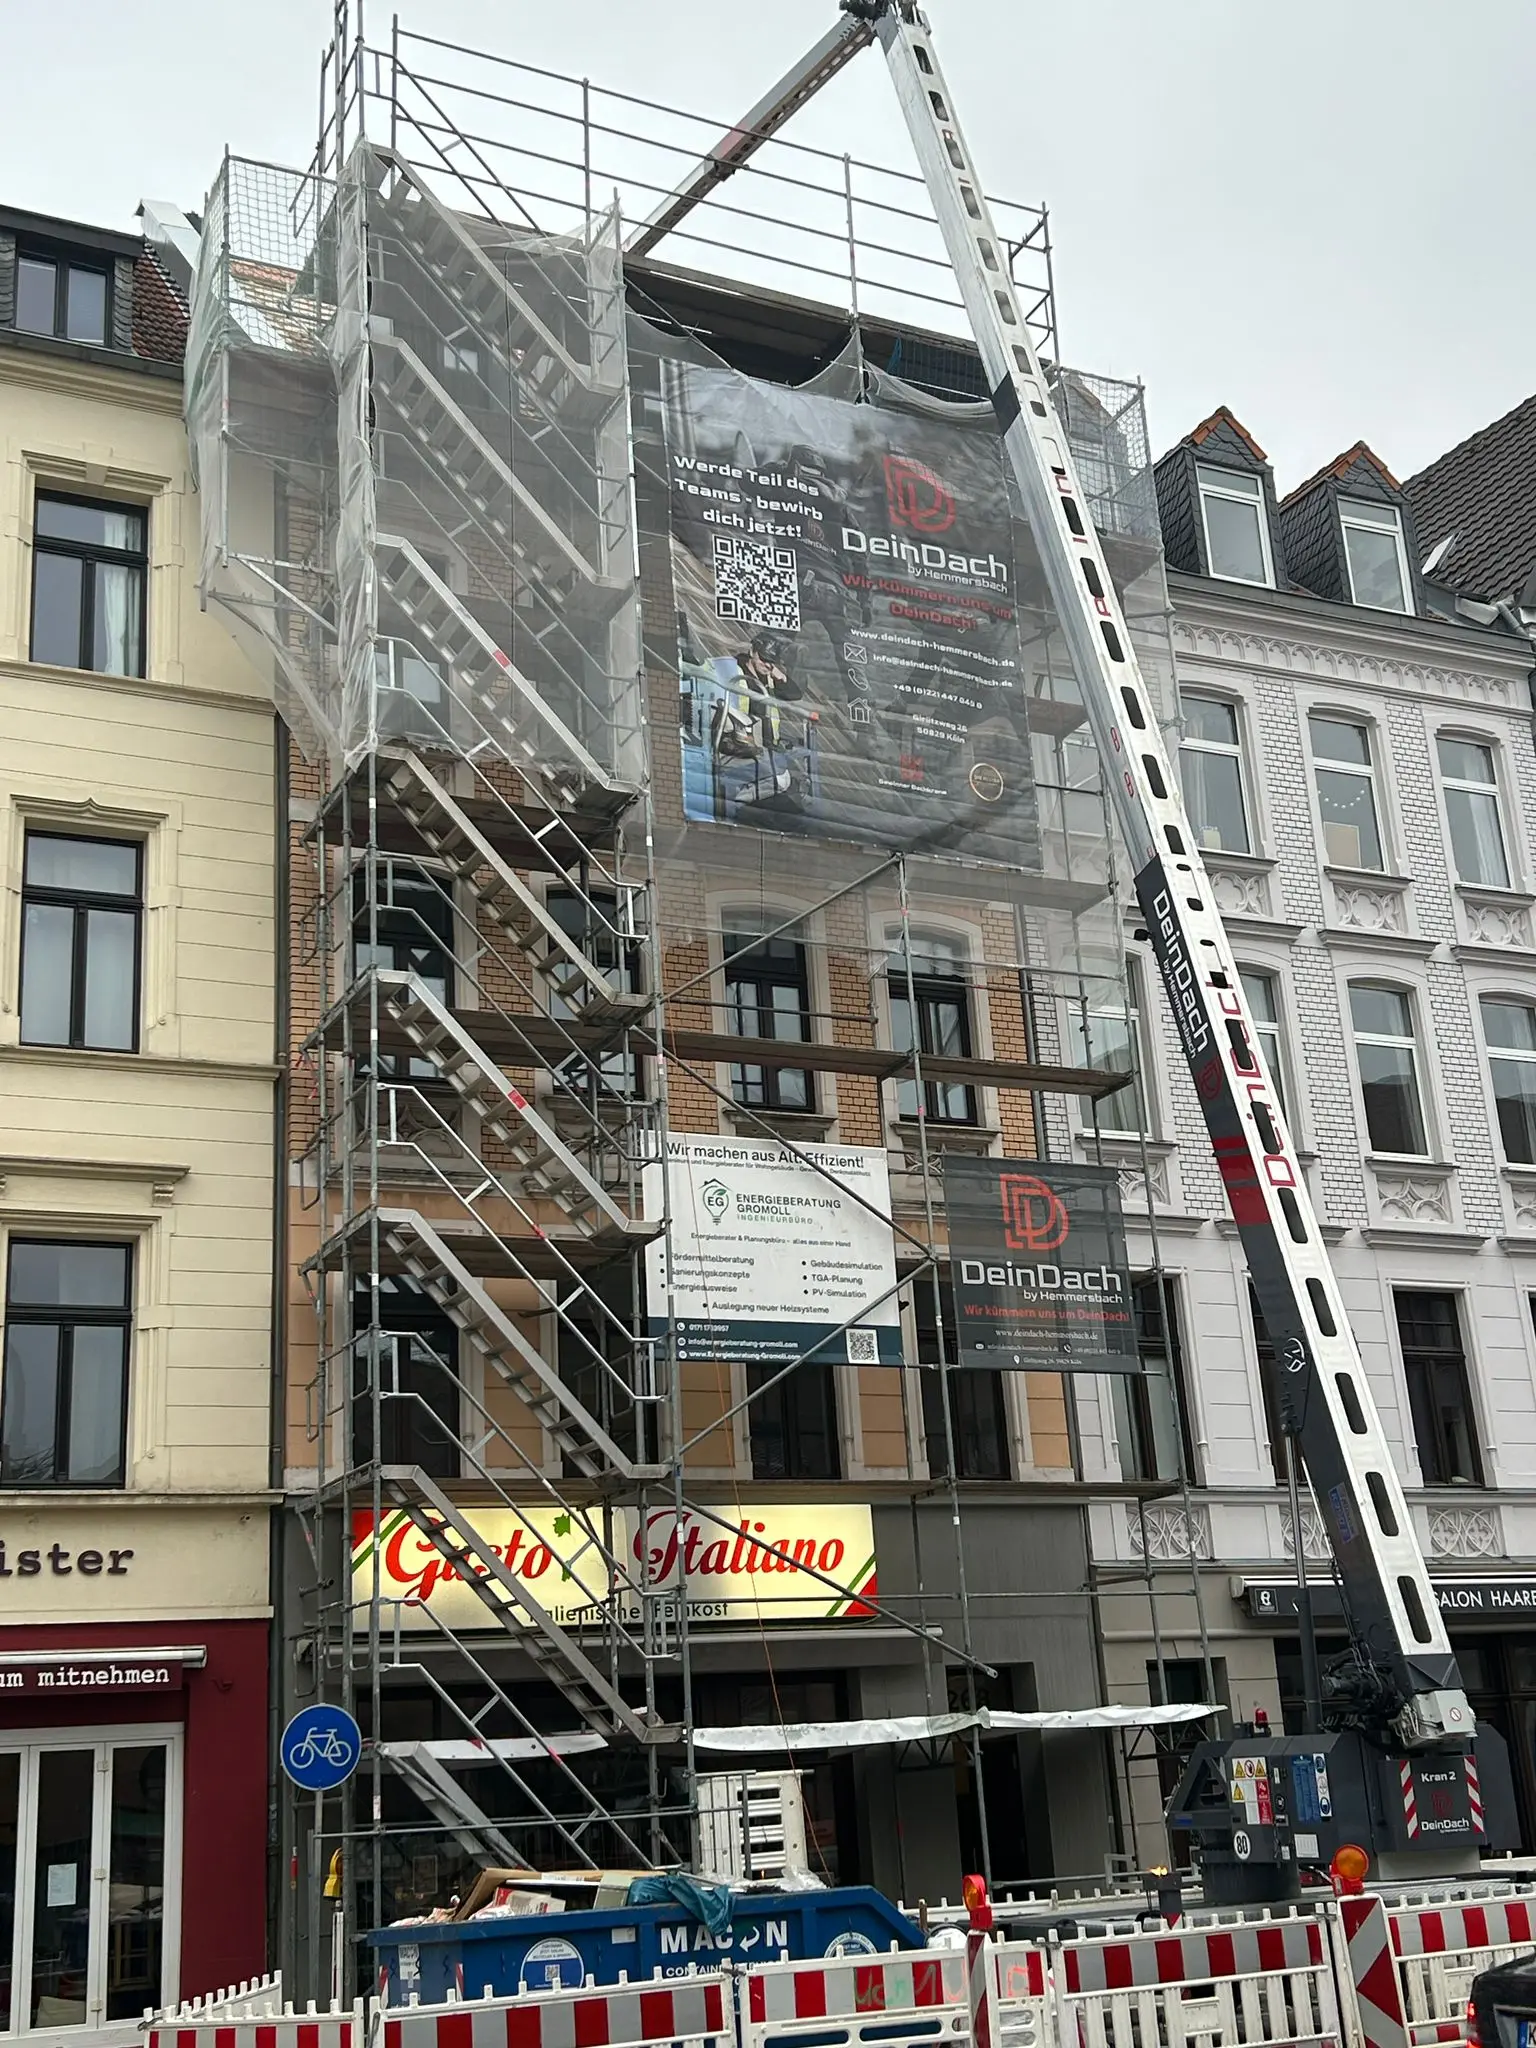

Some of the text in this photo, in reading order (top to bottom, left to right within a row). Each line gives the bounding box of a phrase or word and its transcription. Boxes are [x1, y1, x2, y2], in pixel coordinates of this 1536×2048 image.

[674, 455, 819, 497] Werde Teil des
[674, 478, 741, 503] Teams
[756, 495, 823, 521] bewirb
[703, 509, 801, 538] dich jetzt!
[842, 527, 1008, 582] DeinDach
[907, 563, 1008, 594] by Hemmersbach
[842, 573, 1013, 620] Wir kümmern uns um
[890, 602, 977, 630] DeinDach!
[851, 627, 1015, 668] www.deindach-hemmersbach.de
[873, 653, 1013, 688] info@deindach-hemmersbach.de
[893, 684, 912, 694] +49
[917, 727, 966, 744] 50829 Köln
[1153, 889, 1208, 1053] DeinDach
[1163, 959, 1196, 1059] by Hemmersbach
[667, 1142, 691, 1156] Wir
[694, 1146, 748, 1160] machen
[752, 1151, 775, 1162] aus
[707, 1196, 724, 1207] EG
[736, 1193, 841, 1209] ENERGIEBERATUNG
[737, 1204, 790, 1215] GROMOLL
[737, 1214, 813, 1224] INGENIEURBÜRO
[691, 1232, 737, 1241] Energieberater
[744, 1235, 786, 1244] Planungsbüro
[810, 1259, 883, 1271] Gebäudesimulation
[812, 1274, 863, 1285] TGA-Planung
[960, 1260, 1121, 1292] DeinDach
[812, 1289, 867, 1298] PV-Simulation
[1024, 1290, 1123, 1304] by Hemmersbach
[712, 1302, 829, 1314] Auslegung neuer Heizsysteme
[964, 1305, 1130, 1322] Wir kümmern uns um DeinDach!
[633, 1510, 844, 1584] Italiano
[38, 1664, 169, 1687] mitnehmen
[1421, 1771, 1456, 1782] Kran 2
[1421, 1817, 1470, 1831] DeinDach
[1236, 1835, 1249, 1854] 80
